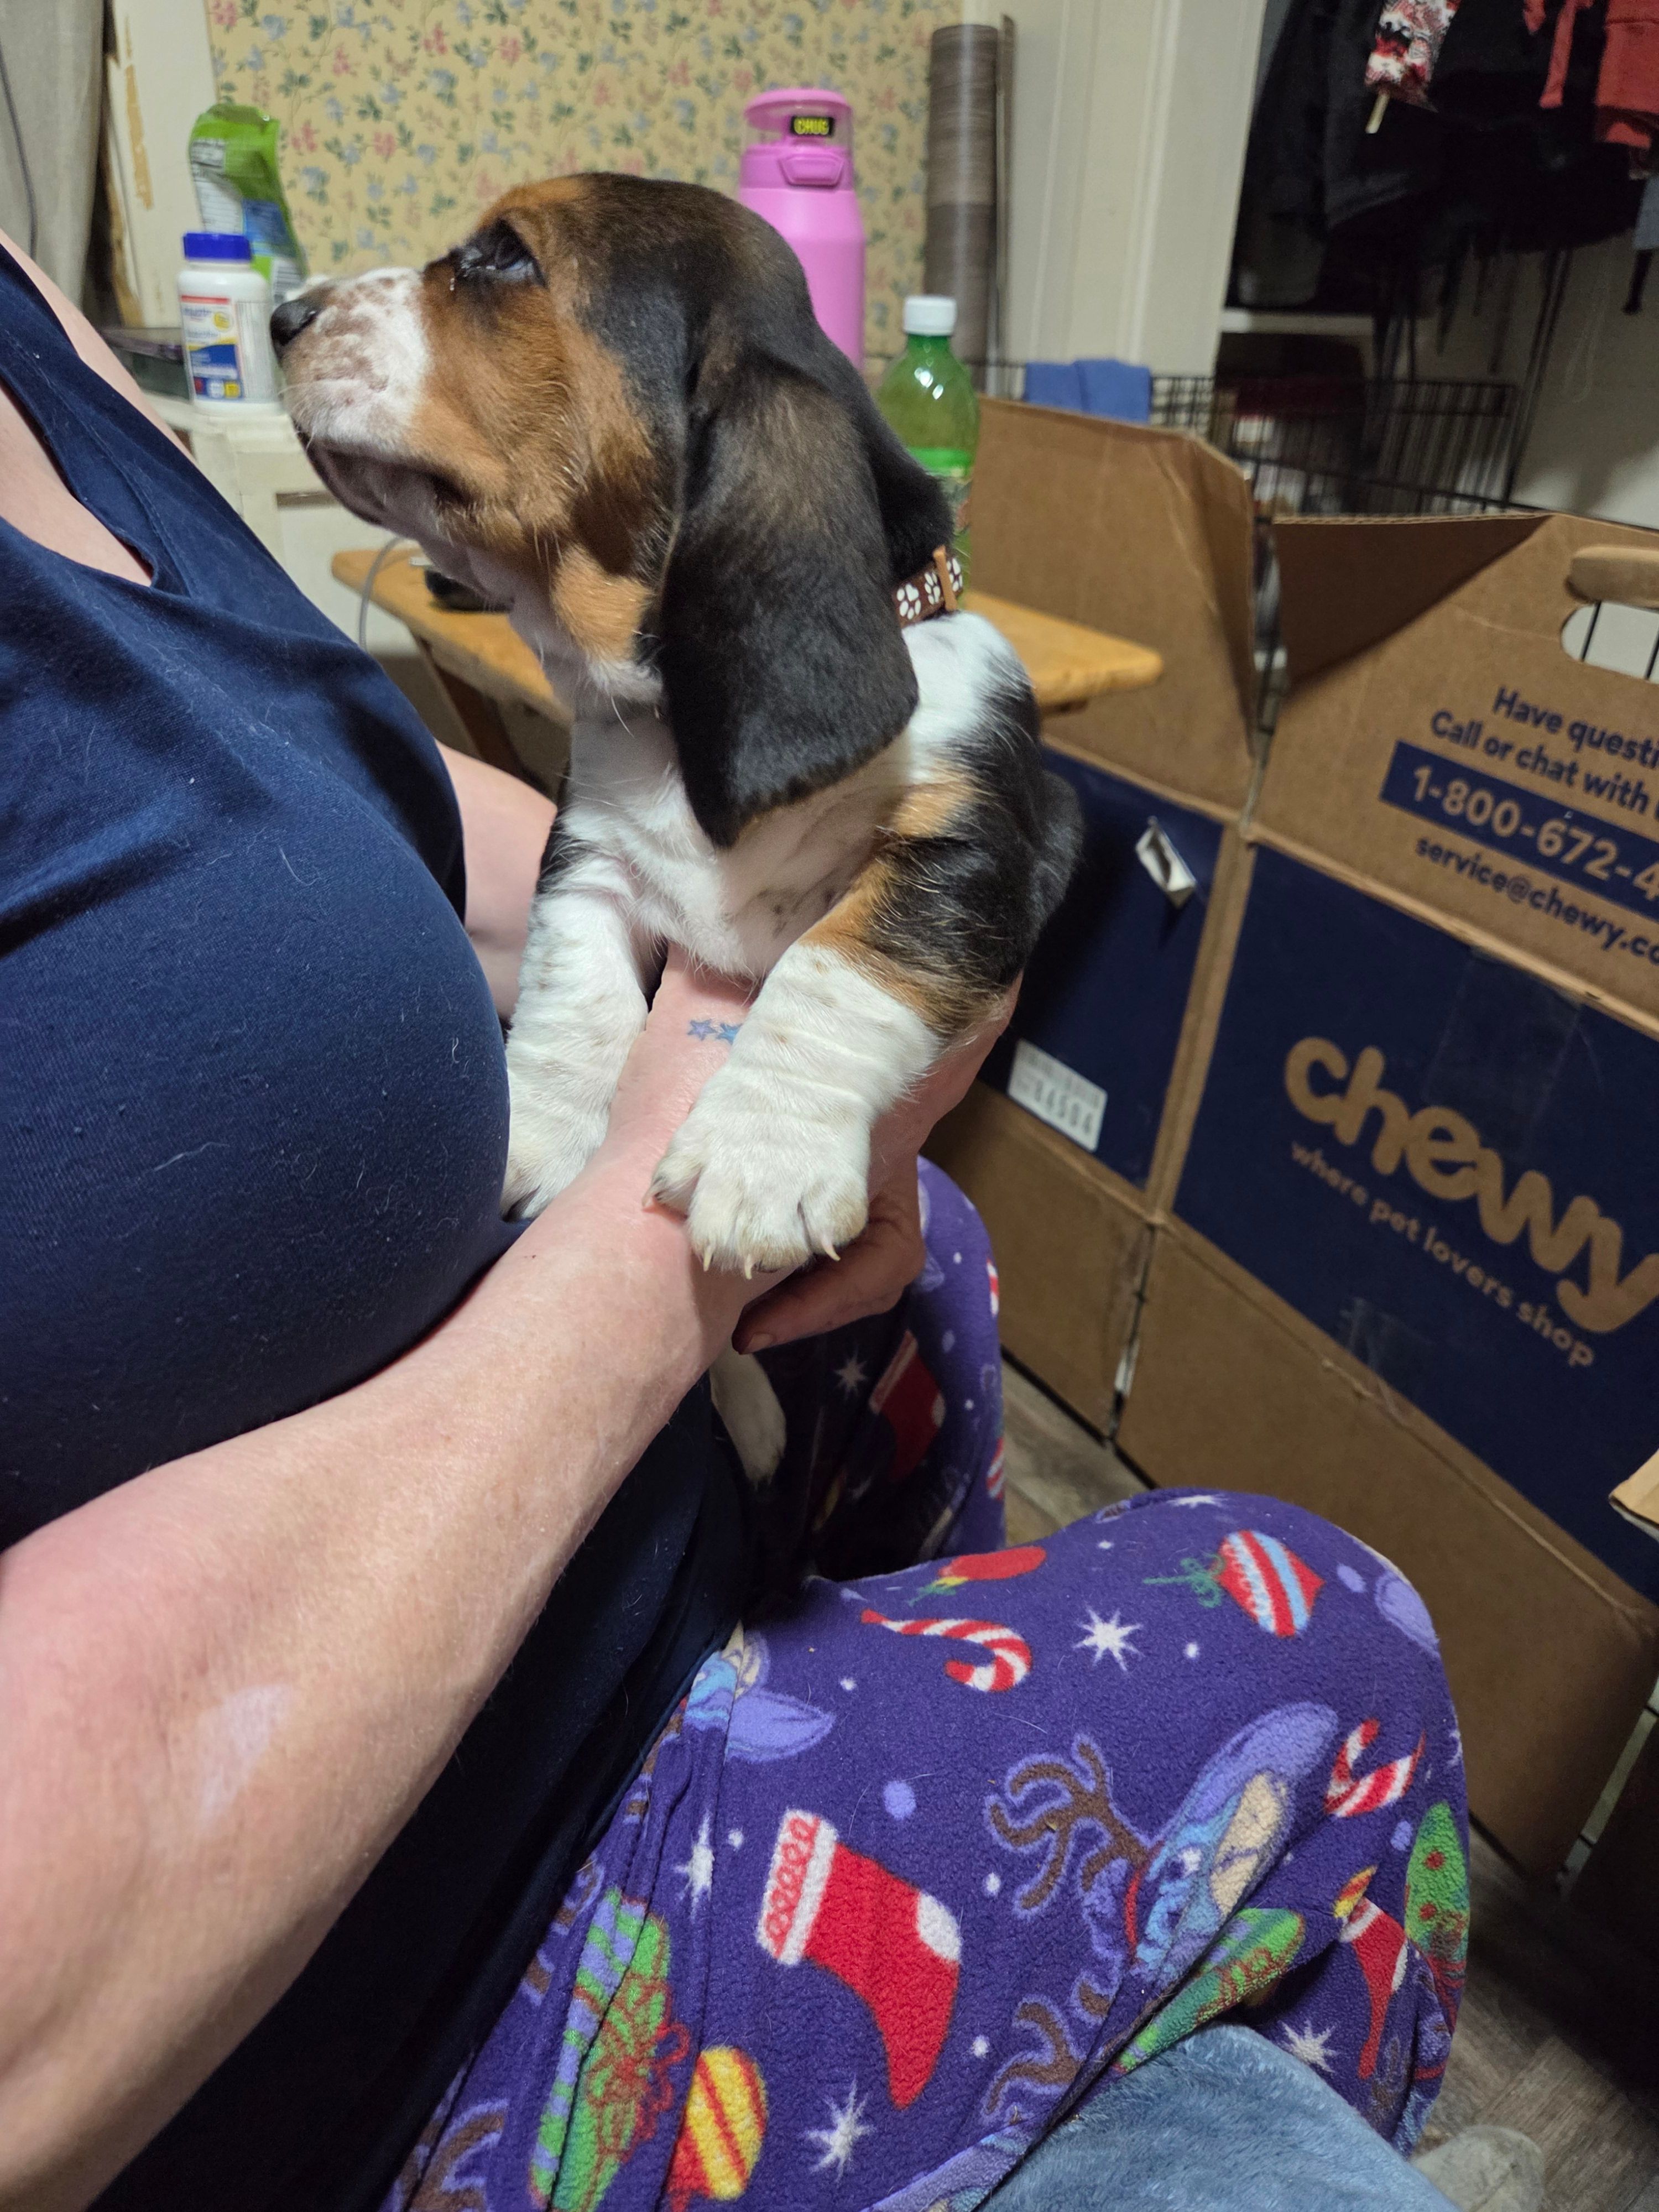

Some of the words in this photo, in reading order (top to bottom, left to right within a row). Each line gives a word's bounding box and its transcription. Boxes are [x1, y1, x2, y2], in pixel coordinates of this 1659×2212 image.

[1431, 710, 1483, 749] Call
[1483, 737, 1514, 761] or
[1515, 744, 1579, 787] chat
[1583, 773, 1649, 815] with
[1494, 685, 1563, 734] Have
[1285, 1036, 1659, 1333] chewy
[1291, 1141, 1369, 1206] where
[1369, 1198, 1422, 1243] pet
[1423, 1226, 1515, 1309] lovers
[1516, 1300, 1595, 1367] shop
